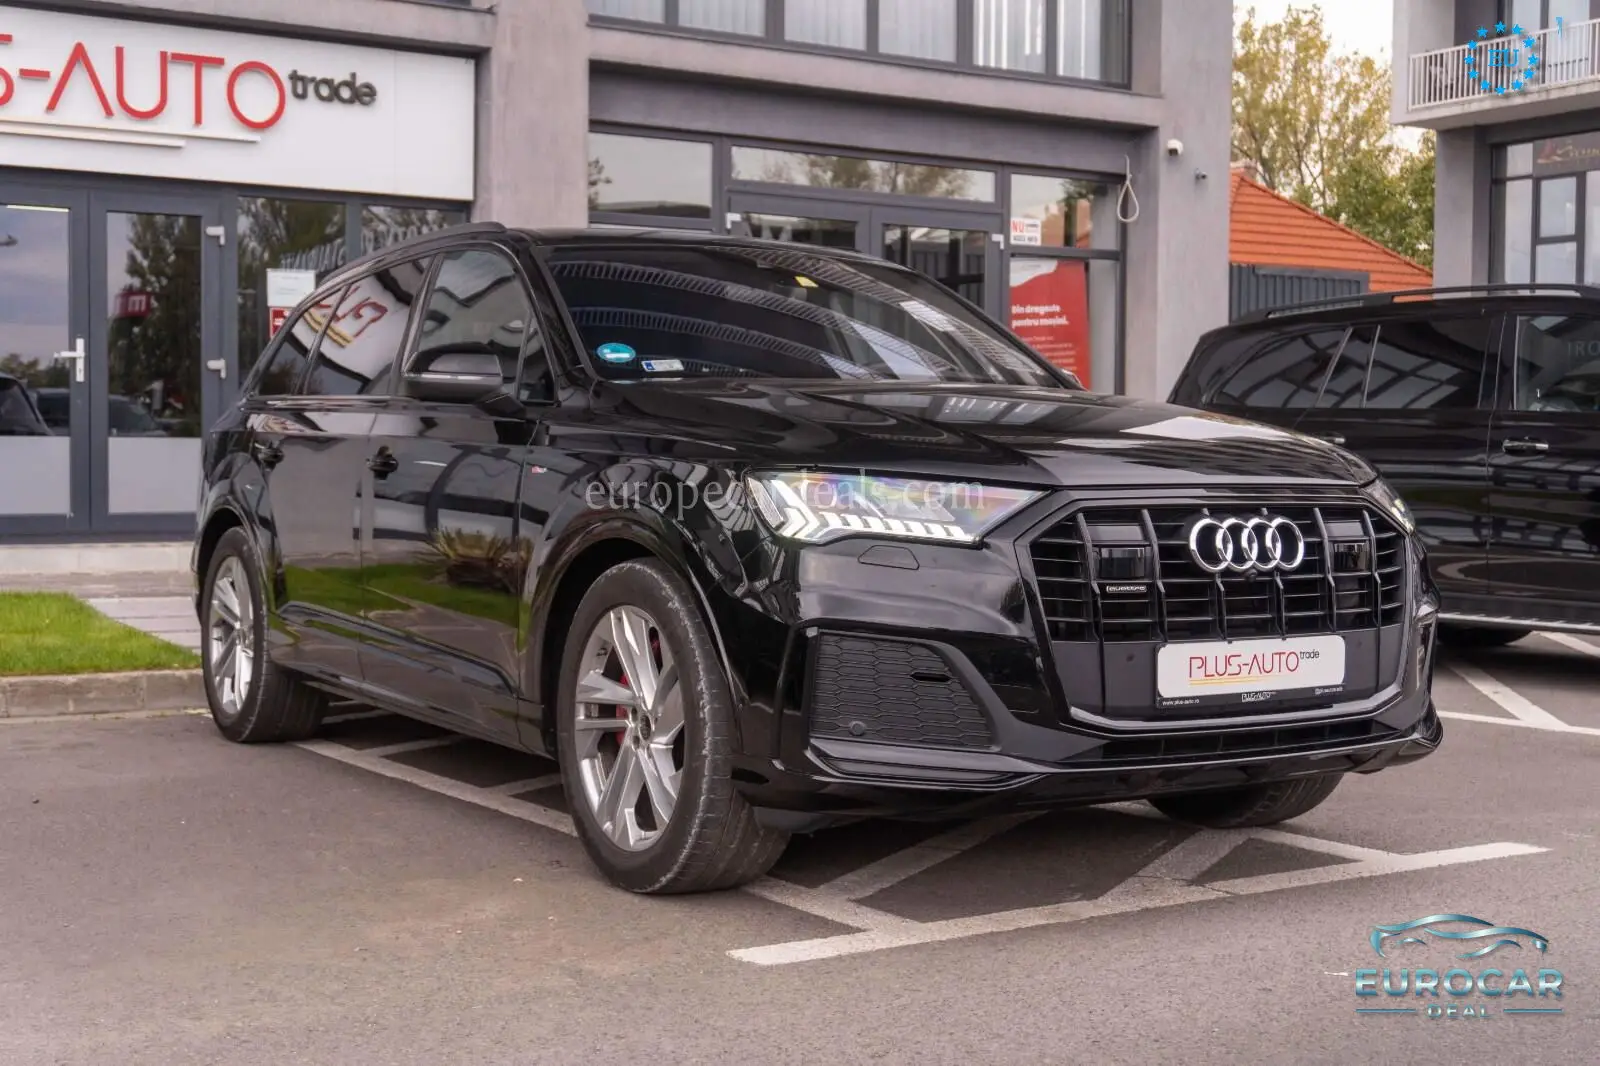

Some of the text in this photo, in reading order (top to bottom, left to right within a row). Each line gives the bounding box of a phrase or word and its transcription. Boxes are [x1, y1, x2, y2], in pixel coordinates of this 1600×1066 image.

[0, 33, 378, 129] -AUTO trade
[1188, 649, 1320, 679] PLUS-AUTO trade
